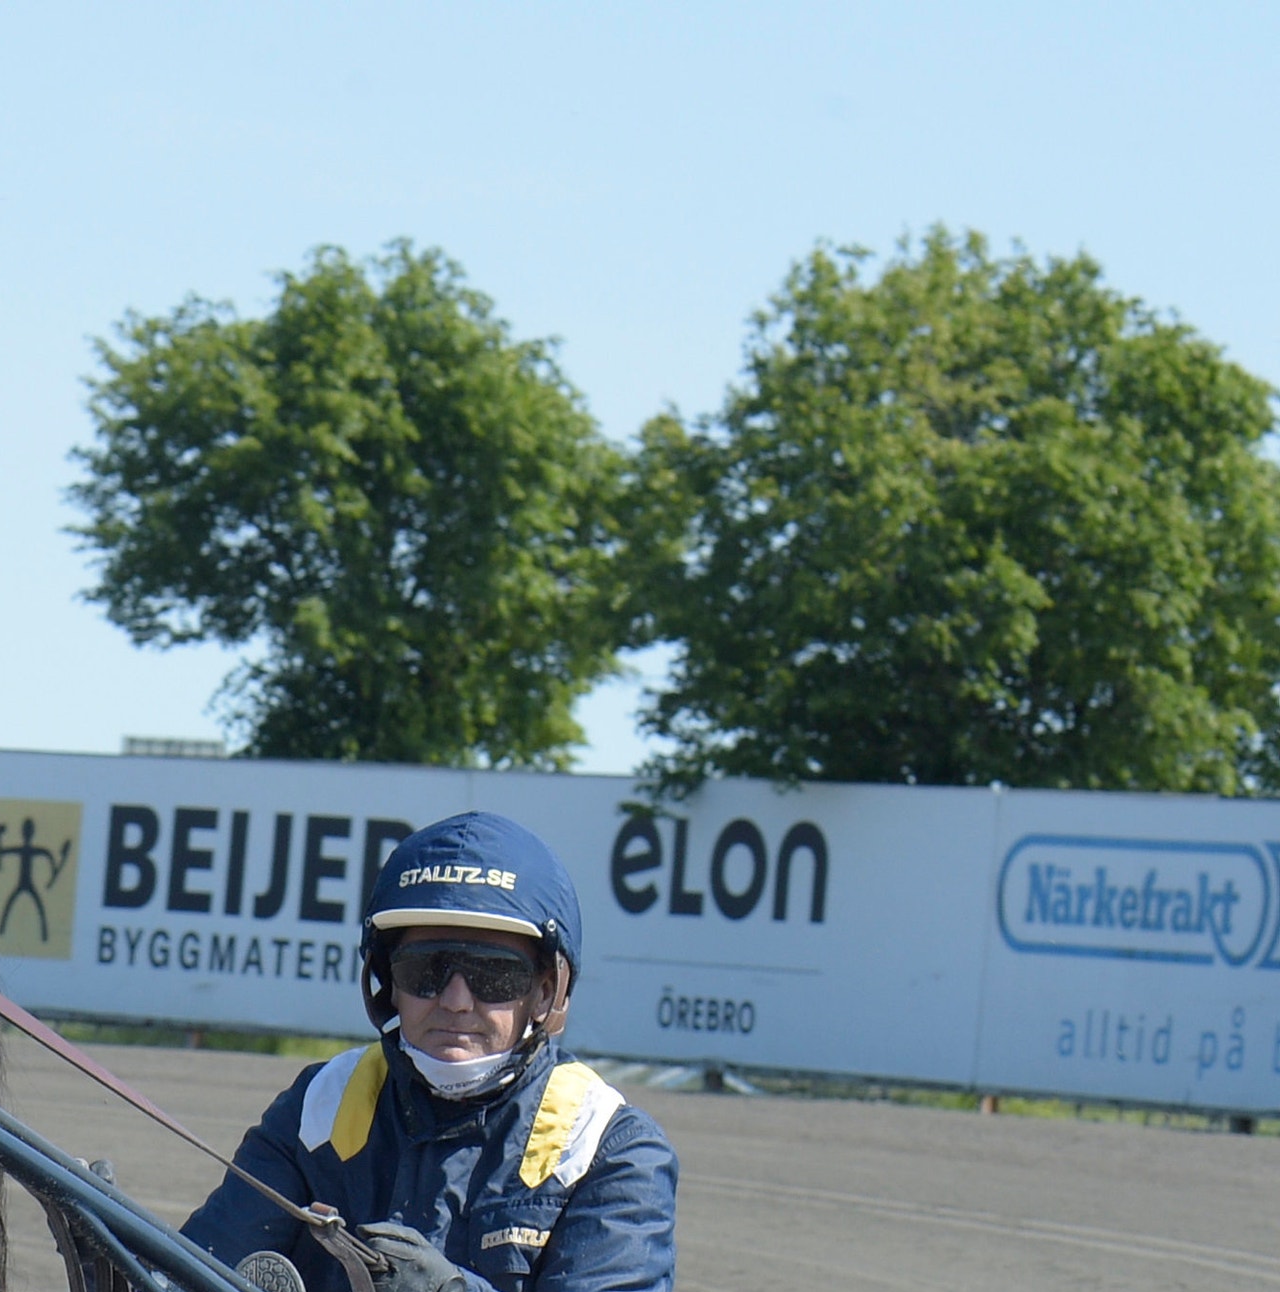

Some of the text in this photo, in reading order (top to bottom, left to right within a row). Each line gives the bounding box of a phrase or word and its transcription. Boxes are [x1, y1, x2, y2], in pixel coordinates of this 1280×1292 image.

[398, 864, 517, 891] STALLTZ.SE
[1025, 861, 1241, 936] Närkefrakt
[96, 926, 359, 984] BYGGMATERI
[657, 984, 755, 1034] ÖREBRO
[1056, 1009, 1174, 1066] alltid
[1196, 1005, 1246, 1081] på
